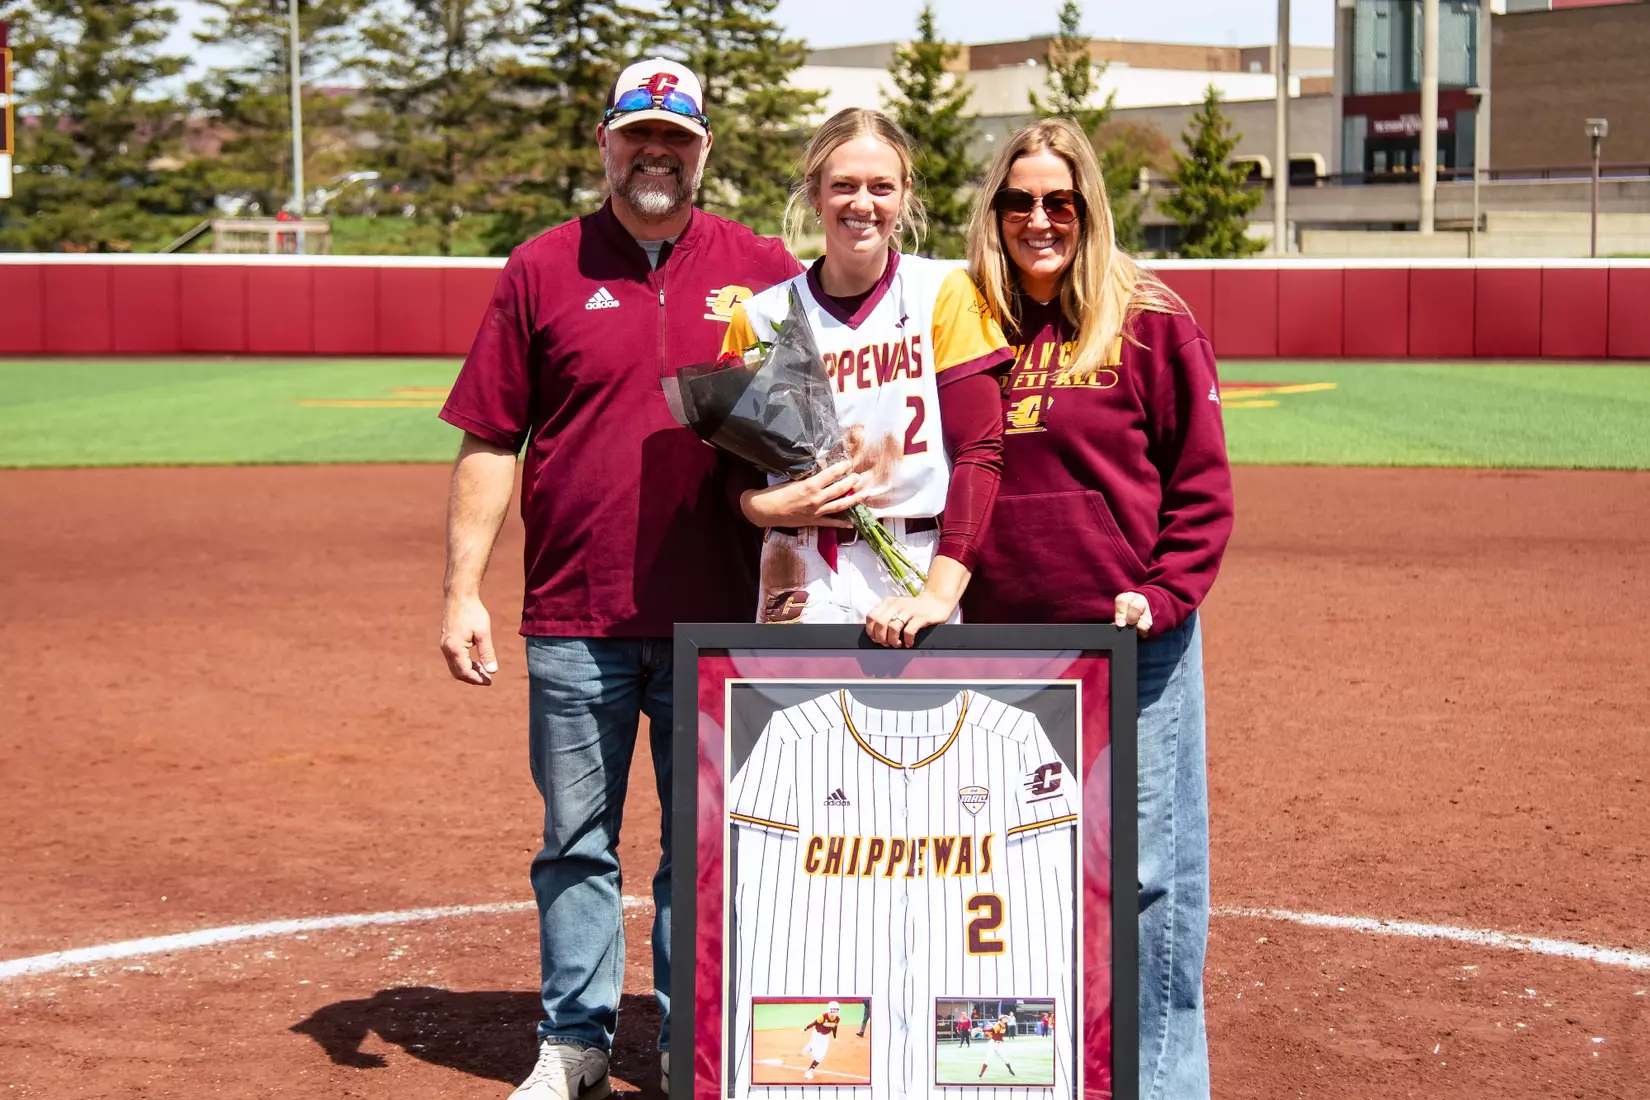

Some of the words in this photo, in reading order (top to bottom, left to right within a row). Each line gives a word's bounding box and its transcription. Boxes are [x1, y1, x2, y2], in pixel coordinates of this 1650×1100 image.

[585, 300, 620, 310] adidas
[822, 333, 923, 393] PPEWAS
[903, 395, 928, 456] 2
[823, 799, 850, 807] adidas
[960, 794, 988, 803] MAC
[804, 834, 995, 878] CHIPPEWAS
[966, 892, 1006, 956] 2
